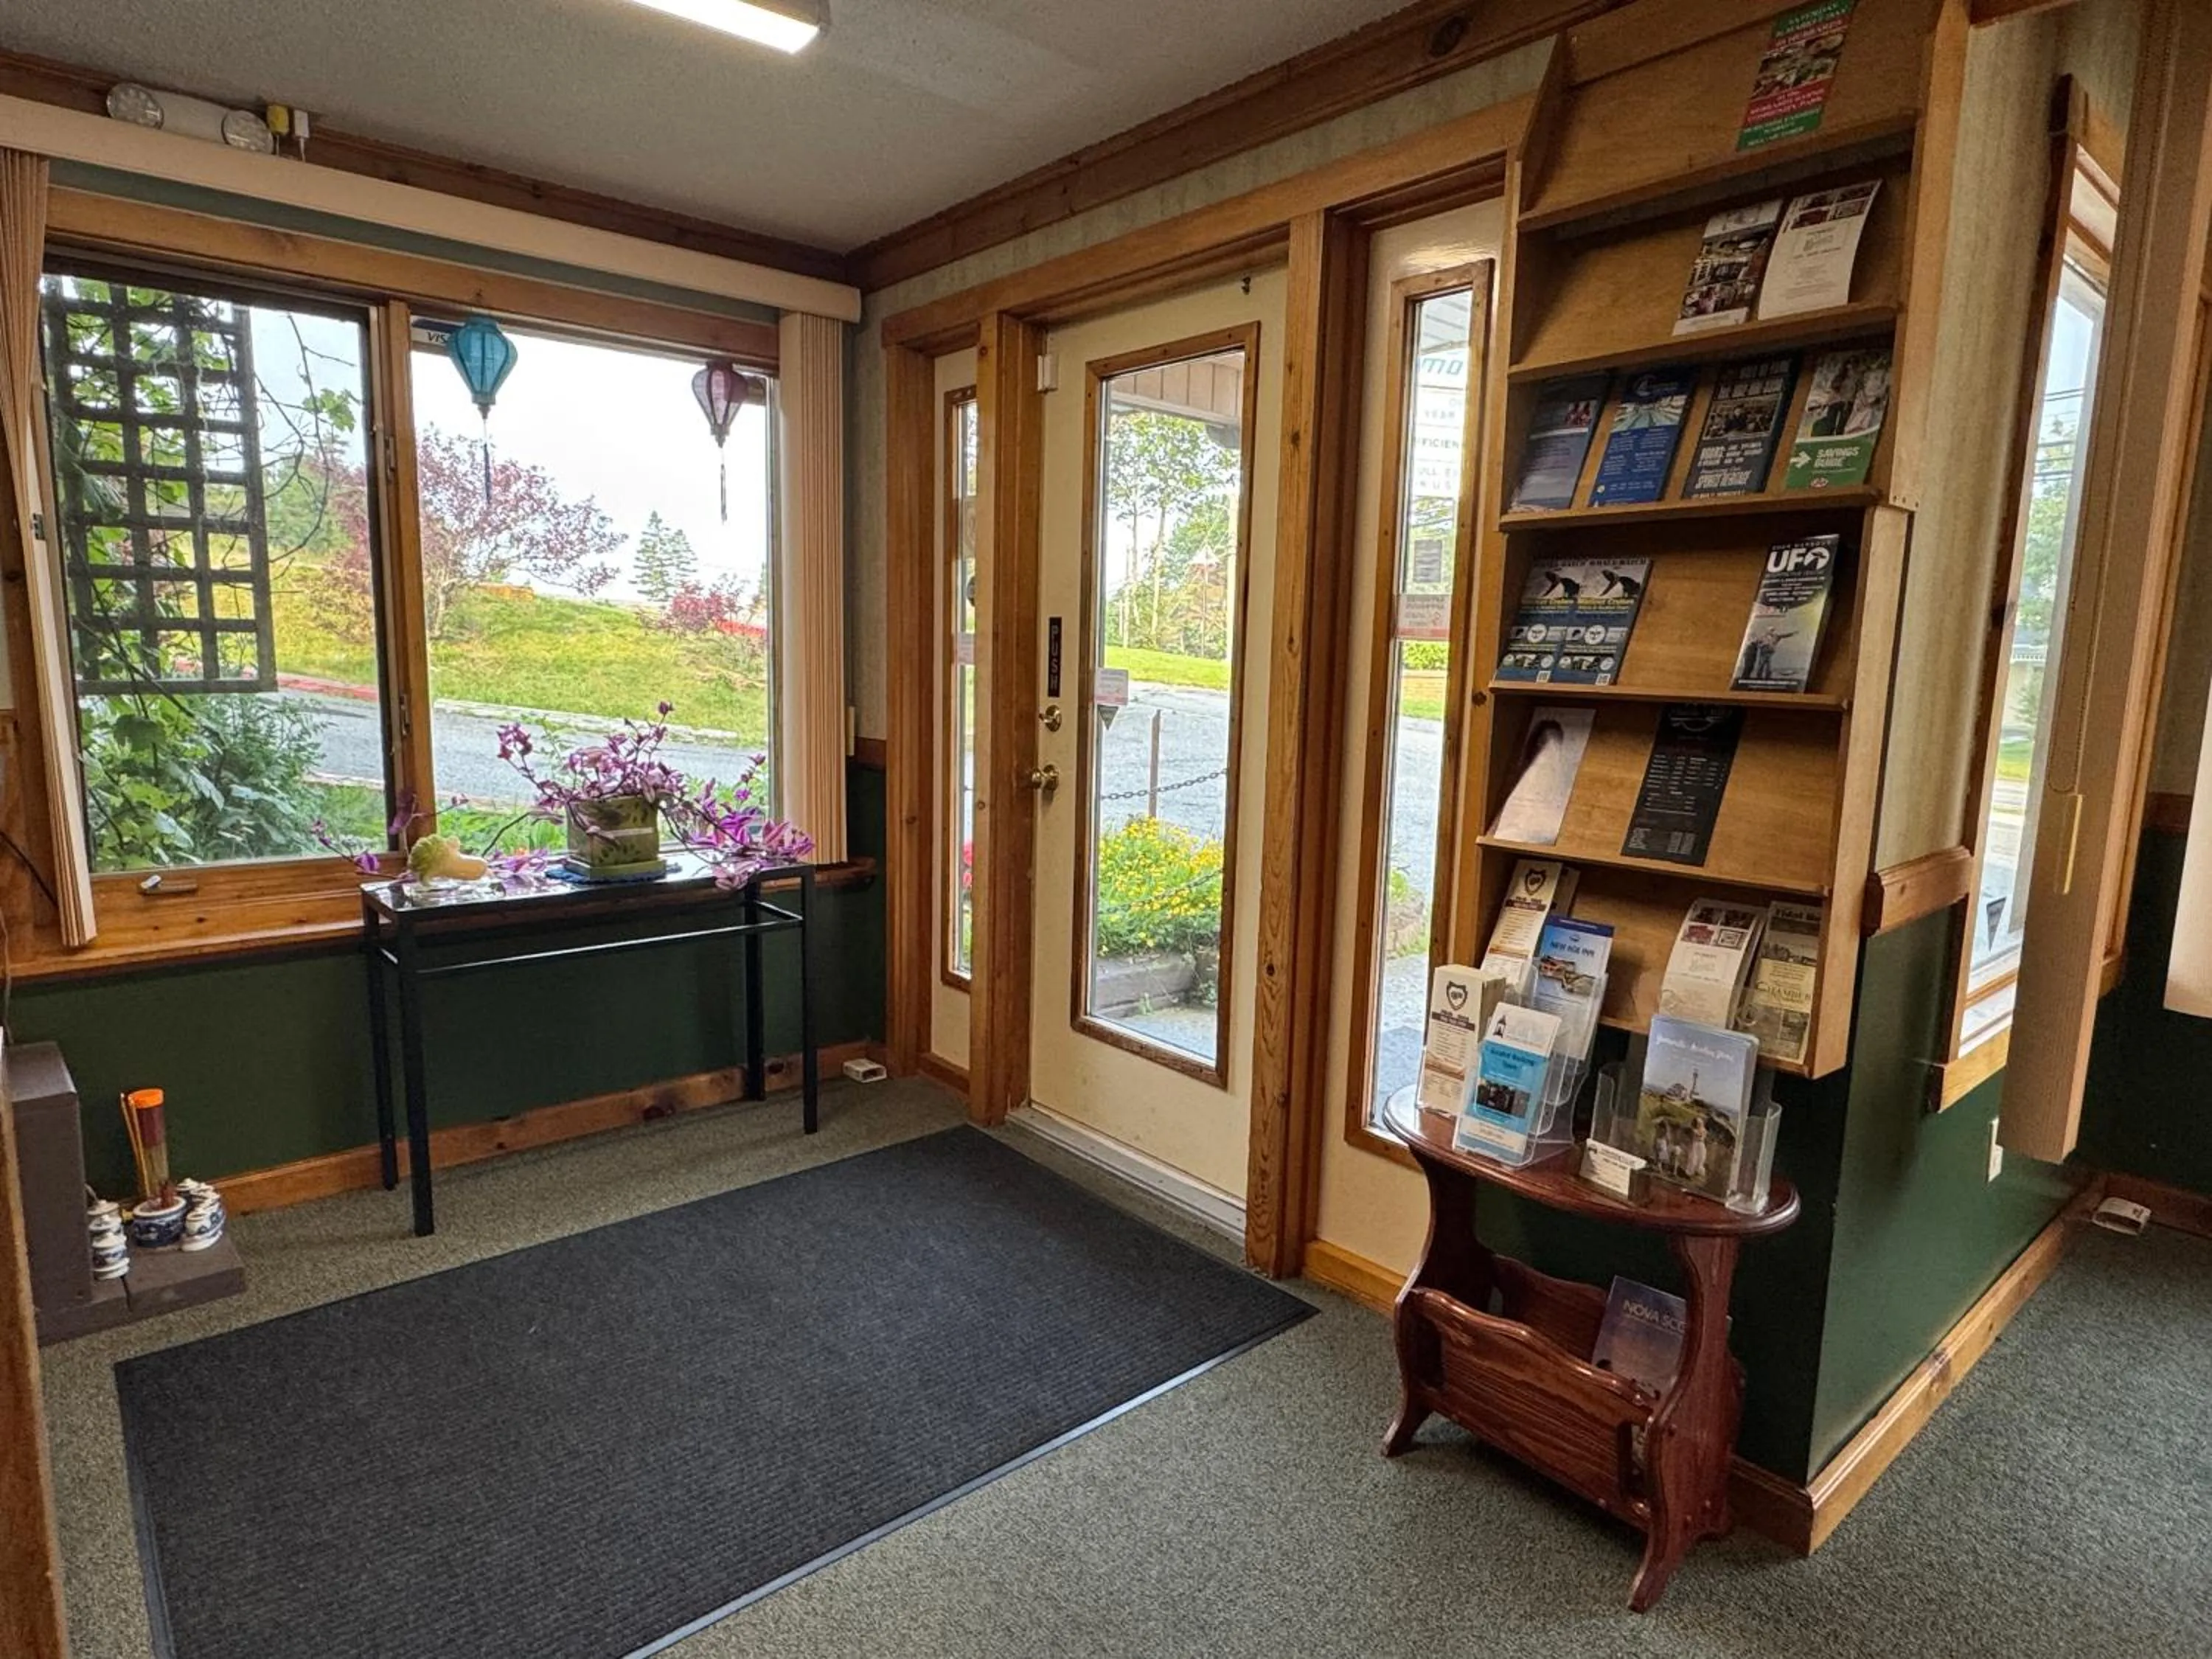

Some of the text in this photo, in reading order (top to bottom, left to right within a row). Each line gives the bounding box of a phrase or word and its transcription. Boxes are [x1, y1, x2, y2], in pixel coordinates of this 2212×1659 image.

[428, 331, 449, 342] VIS
[1767, 546, 1830, 573] UFO
[1050, 625, 1060, 691] PUSH
[1623, 1299, 1659, 1323] NOVA
